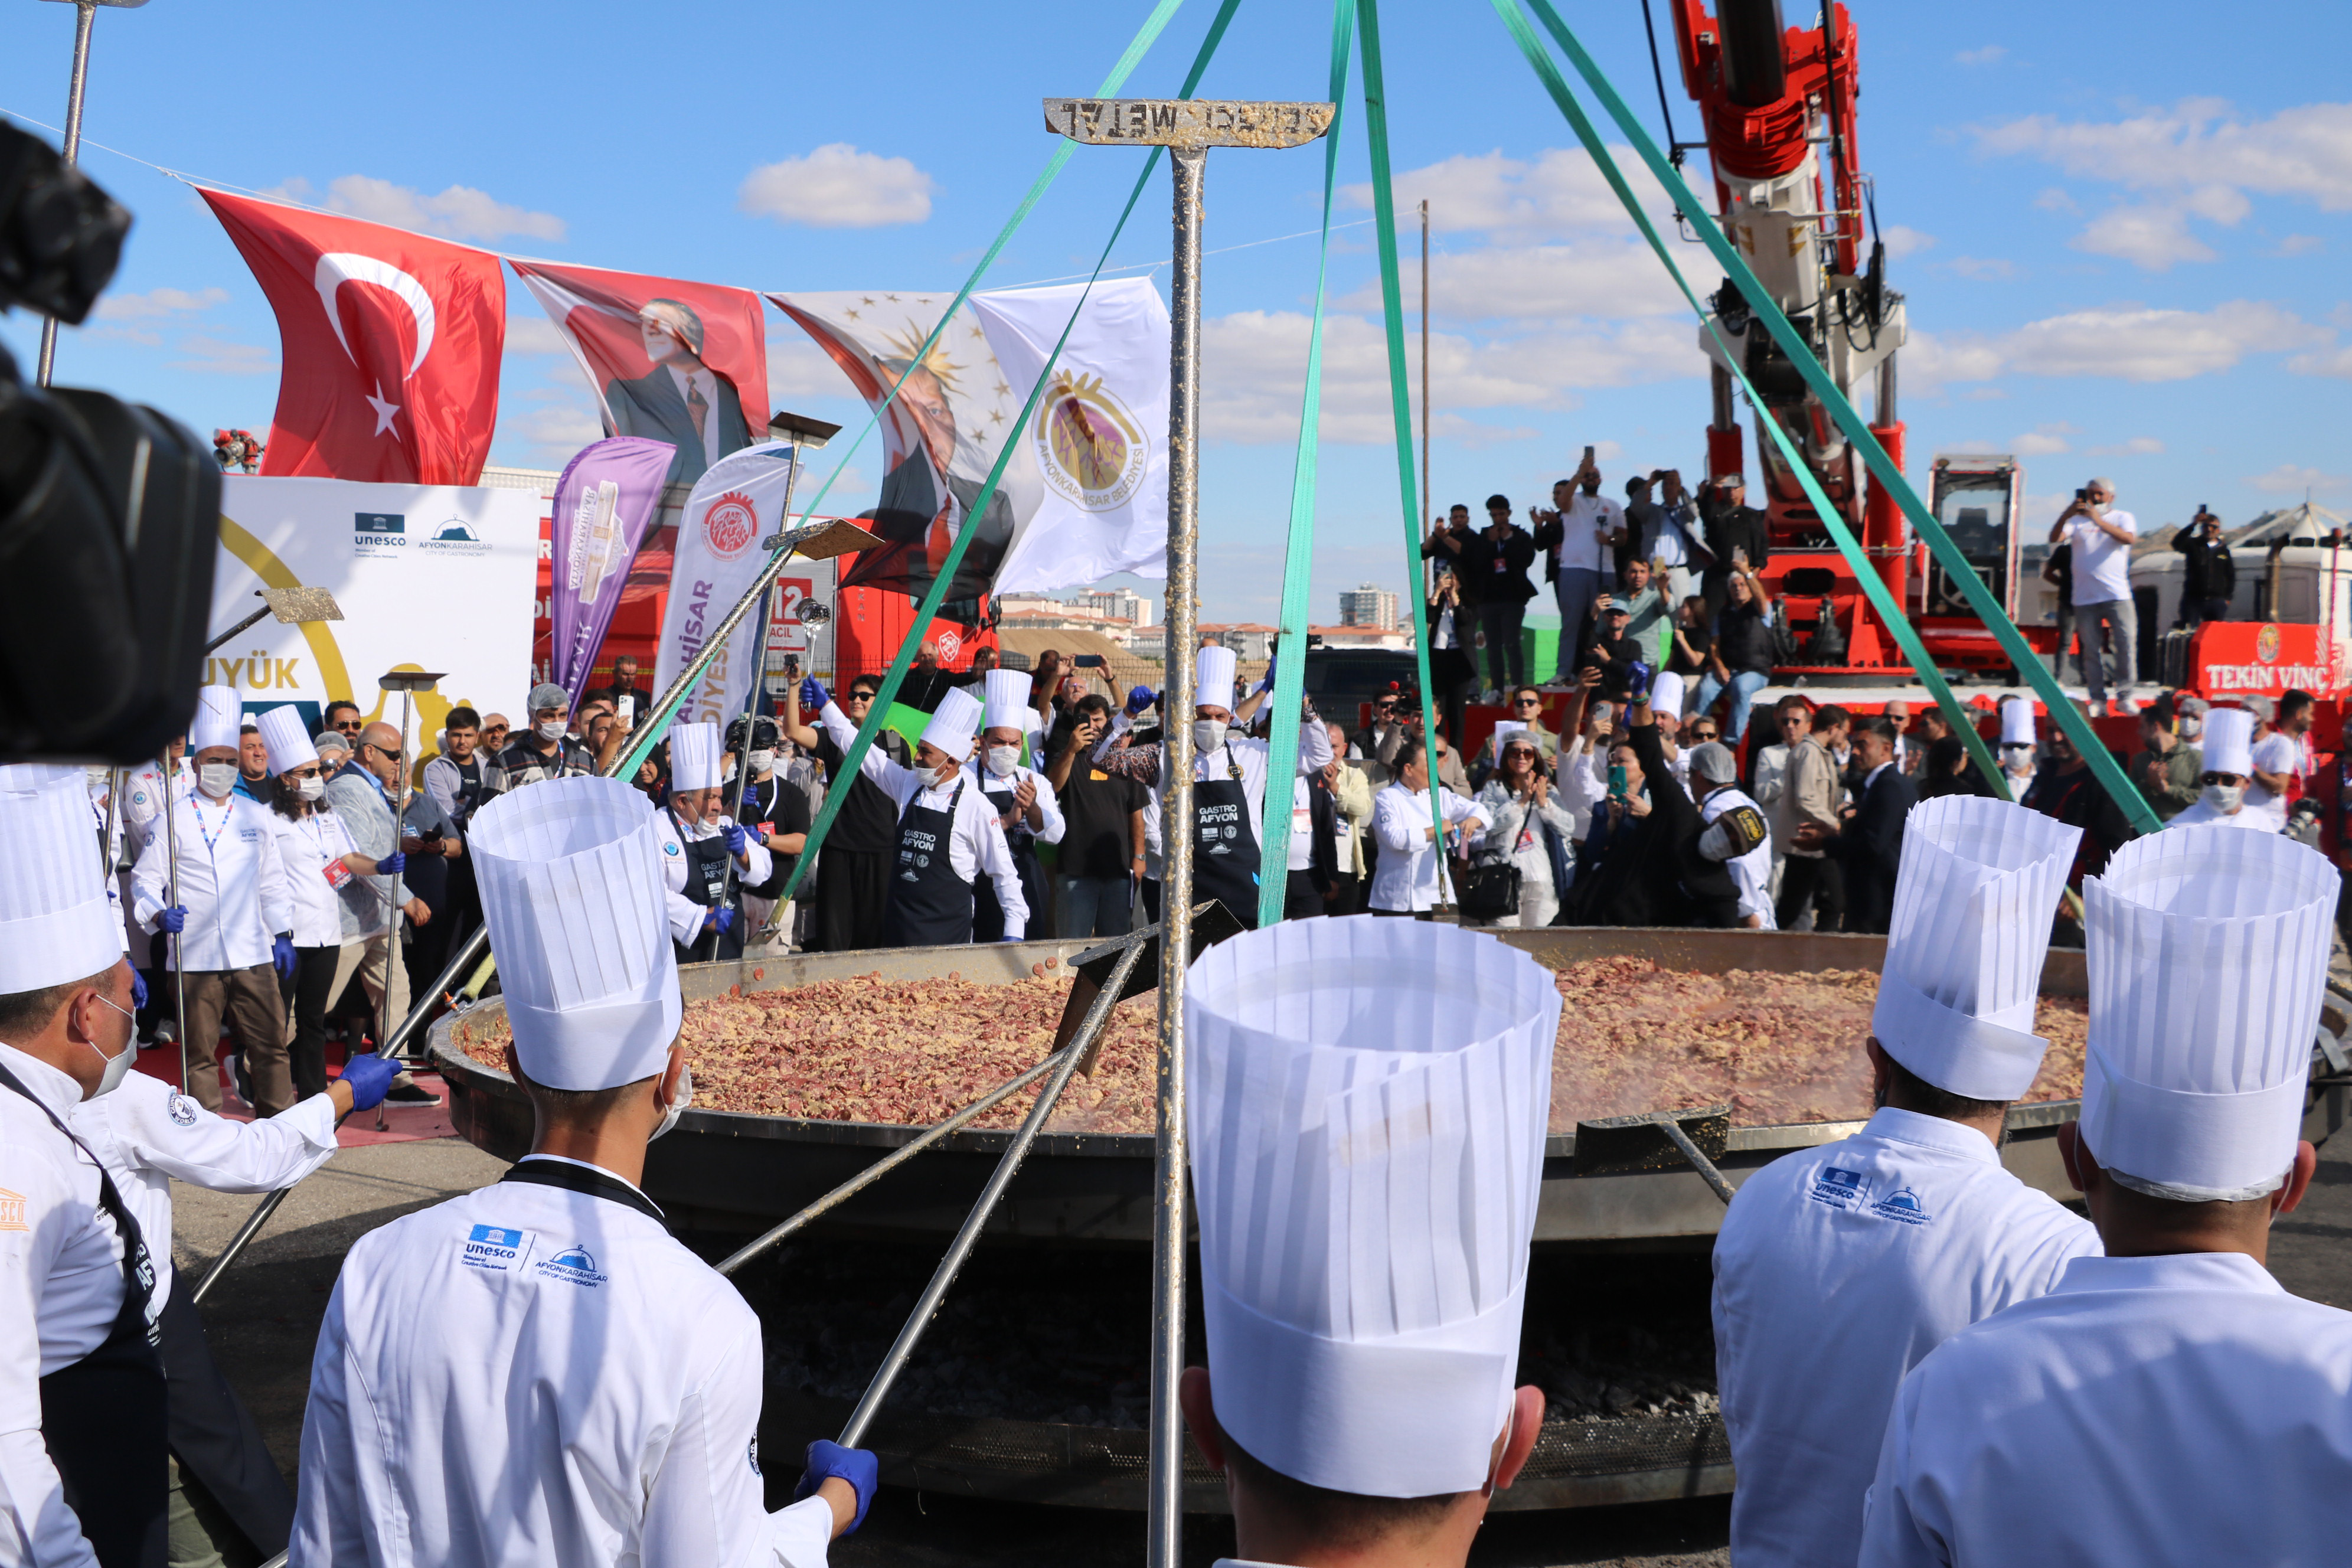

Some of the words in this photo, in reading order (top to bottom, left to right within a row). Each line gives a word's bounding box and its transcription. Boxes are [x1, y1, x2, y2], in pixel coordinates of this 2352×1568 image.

[1113, 447, 1144, 502] BELEDİYESİ
[355, 535, 406, 546] unesco
[769, 626, 792, 638] ACİL
[2205, 661, 2274, 690] TEKİN
[2278, 662, 2328, 695] VİNÇ
[1199, 804, 1237, 815] GASTRO
[1200, 812, 1238, 824] AFYON
[904, 829, 936, 842] GASTRO
[902, 837, 934, 851] AFYON
[175, 1115, 194, 1124] WORLD
[1815, 1182, 1855, 1200] unesco
[466, 1243, 516, 1259] unesco
